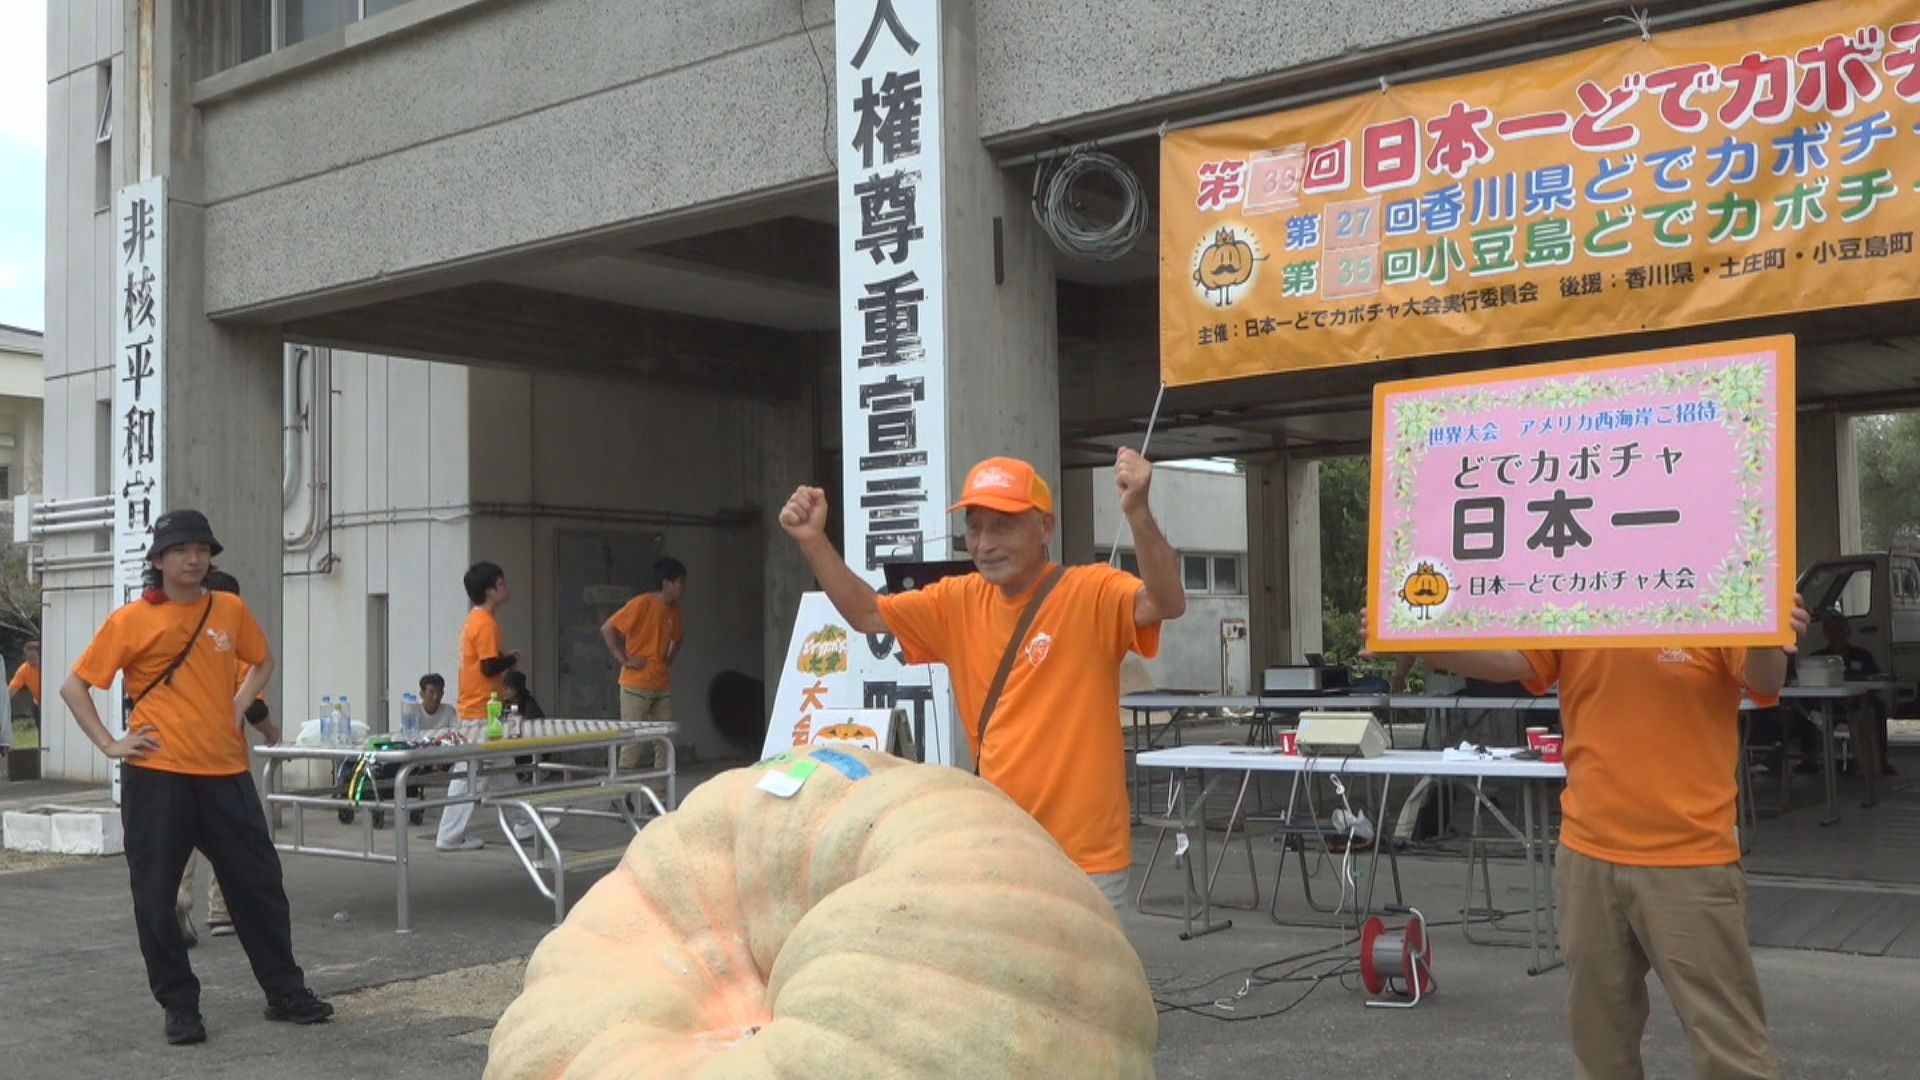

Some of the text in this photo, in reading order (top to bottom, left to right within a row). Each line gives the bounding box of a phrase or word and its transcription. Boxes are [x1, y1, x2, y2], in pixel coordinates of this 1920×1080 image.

[1286, 112, 1920, 250] 第27回香川県どでカボチ
[1281, 170, 1920, 297] 第35回小豆島どでカボチ
[1428, 401, 1720, 446] 世界大会 アメリカ西海岸ご招待
[1454, 443, 1684, 490] どでカボチャ
[1452, 489, 1681, 560] 日本一
[1469, 567, 1696, 597] 日本一どでカボチャ大会
